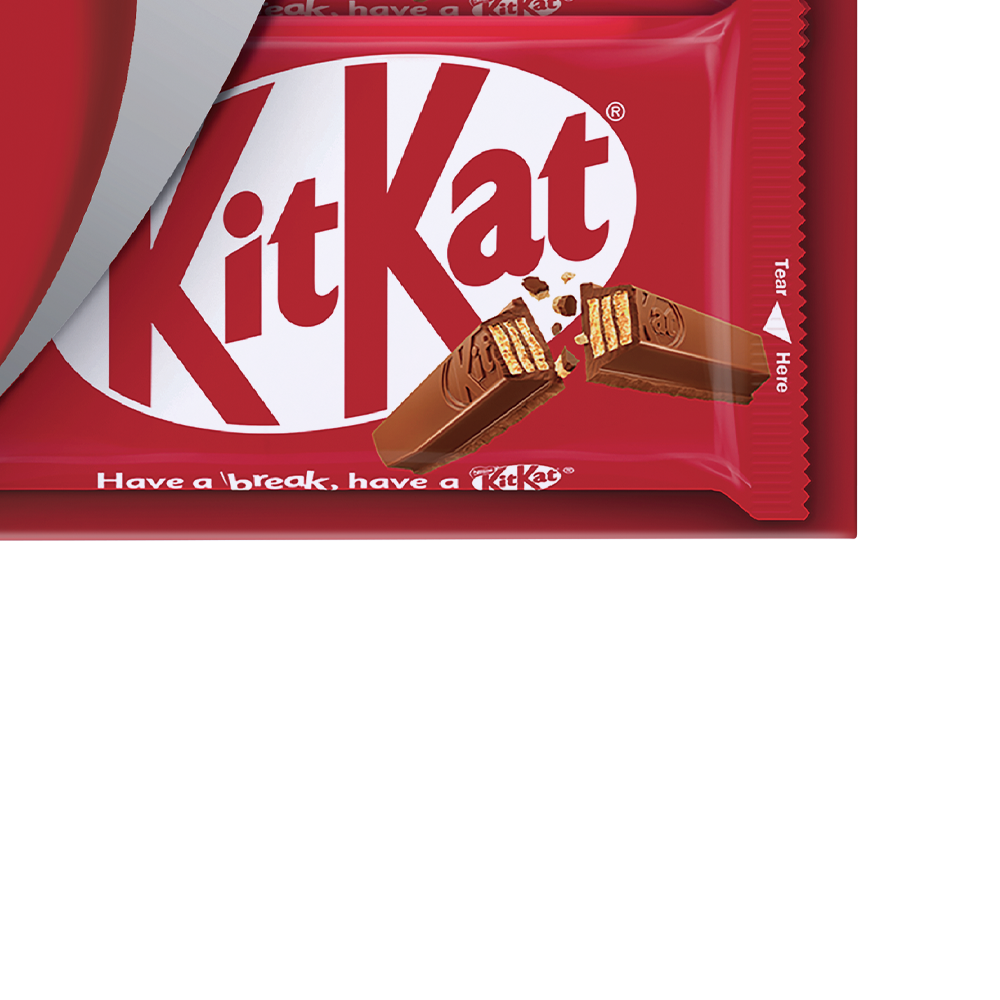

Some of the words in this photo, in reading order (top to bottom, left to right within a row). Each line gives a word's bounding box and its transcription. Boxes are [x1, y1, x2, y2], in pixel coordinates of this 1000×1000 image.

[349, 0, 427, 16] have
[440, 6, 458, 16] a
[109, 62, 609, 426] KitKat
[775, 259, 789, 297] Tear
[776, 353, 790, 393] Here
[98, 472, 183, 489] Have
[193, 478, 212, 489] a
[349, 473, 427, 489] have
[439, 478, 459, 489] a
[481, 464, 558, 490] KitKat
